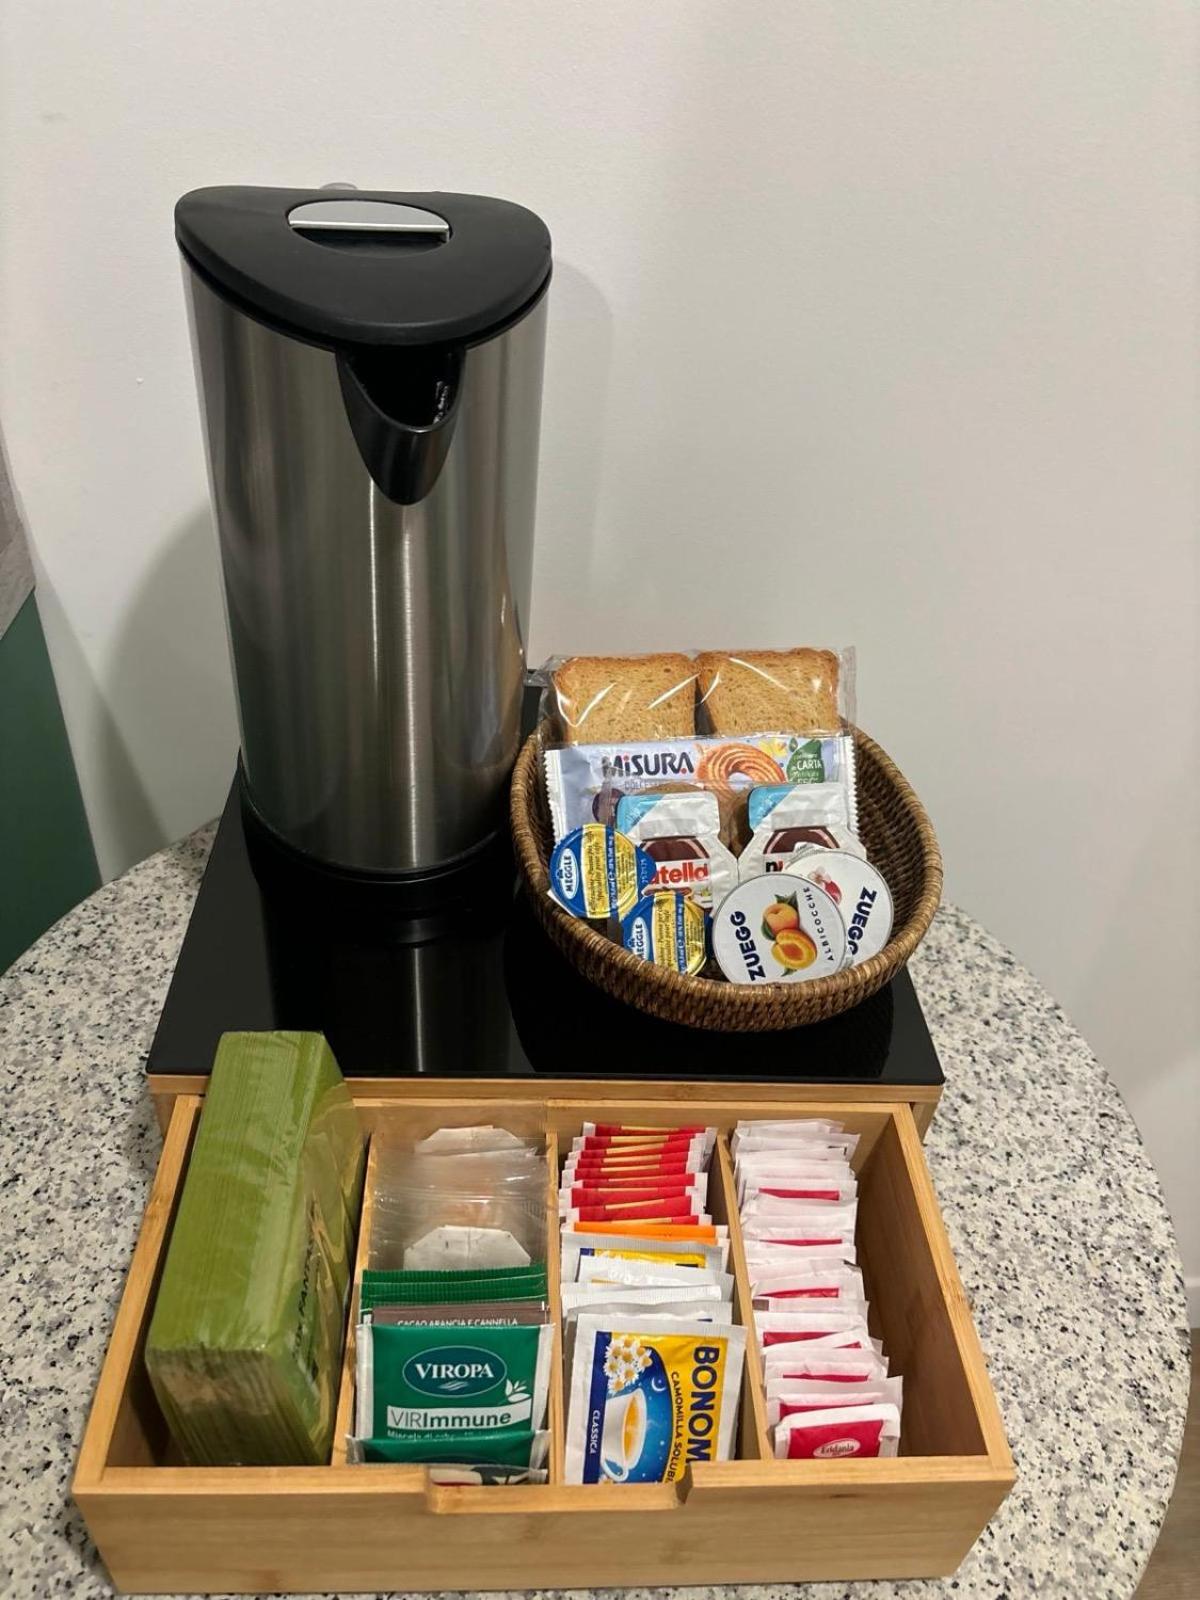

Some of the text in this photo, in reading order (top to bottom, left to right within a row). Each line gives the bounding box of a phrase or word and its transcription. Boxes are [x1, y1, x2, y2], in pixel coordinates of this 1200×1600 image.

[563, 854, 573, 893] MEGGLE
[730, 910, 766, 981] ZUEGG
[803, 886, 834, 961] ALBICOCCHE
[415, 1363, 494, 1379] VIROPA
[390, 1409, 512, 1428] VIRImmune
[589, 1409, 600, 1454] CLASSICA
[671, 1371, 685, 1439] CAMOMILLA
[685, 1346, 720, 1464] BONOM
